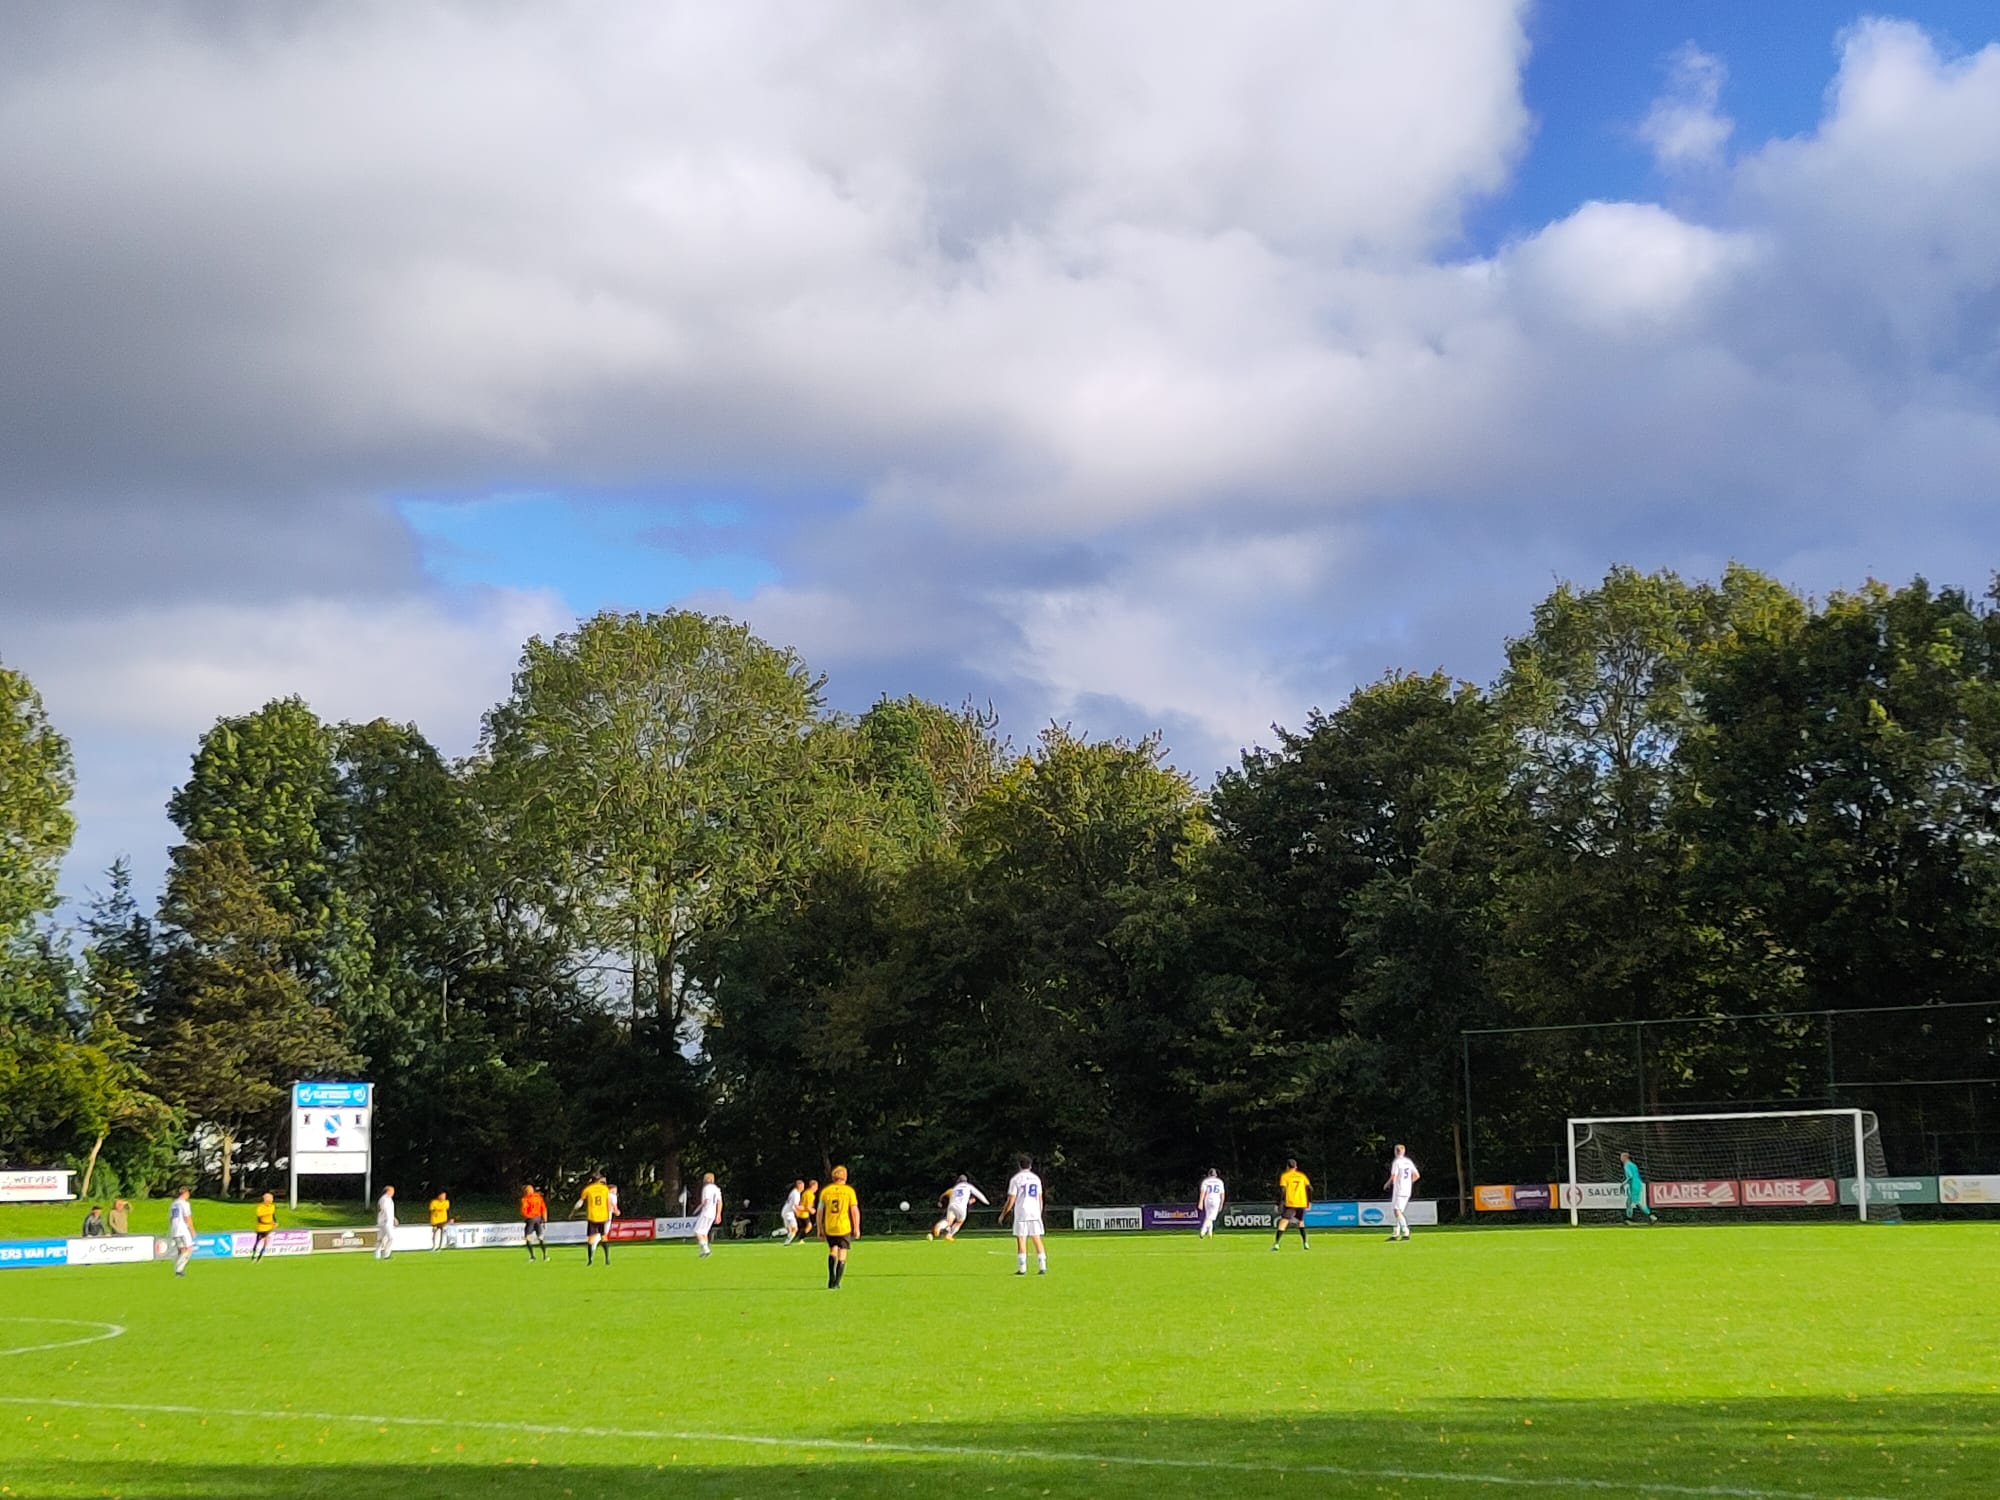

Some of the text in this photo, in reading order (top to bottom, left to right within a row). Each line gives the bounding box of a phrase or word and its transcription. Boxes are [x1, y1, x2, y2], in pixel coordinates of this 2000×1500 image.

[1403, 1168, 1409, 1179] 5
[1020, 1183, 1038, 1197] 18
[1292, 1181, 1300, 1191] 7
[1653, 1183, 1707, 1200] KLAREE
[1745, 1182, 1801, 1199] KLAREE
[831, 1199, 840, 1214] 3
[1224, 1215, 1272, 1227] 5VOOR12
[24, 1248, 44, 1258] VAN
